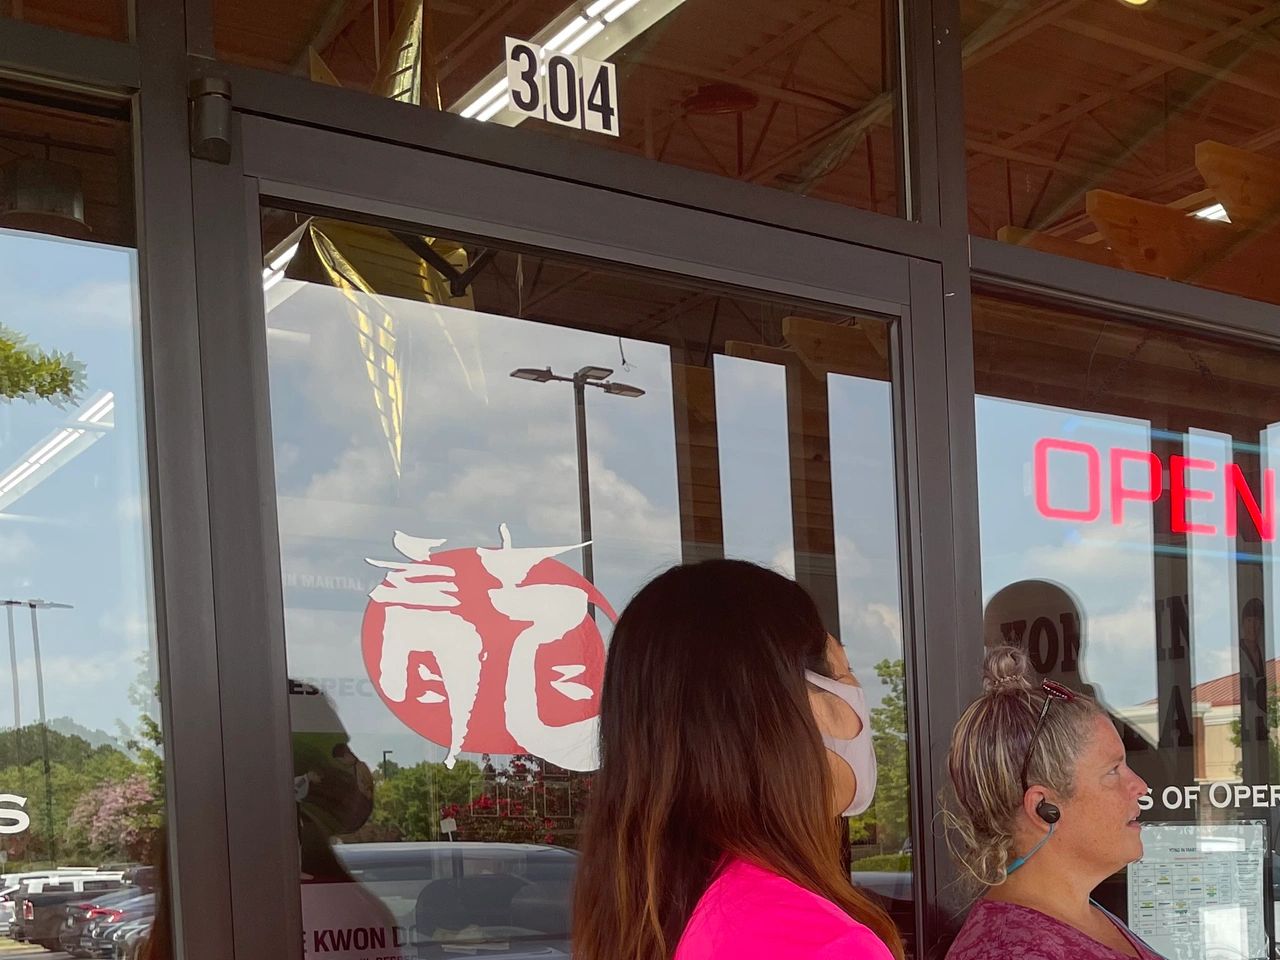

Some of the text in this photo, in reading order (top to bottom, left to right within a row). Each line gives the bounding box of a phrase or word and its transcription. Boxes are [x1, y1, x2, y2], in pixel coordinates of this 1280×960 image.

[511, 44, 615, 131] 304
[1033, 437, 1276, 542] OPEN
[288, 678, 373, 698] ESPEC
[1162, 786, 1200, 809] OF
[314, 926, 385, 952] KWON
